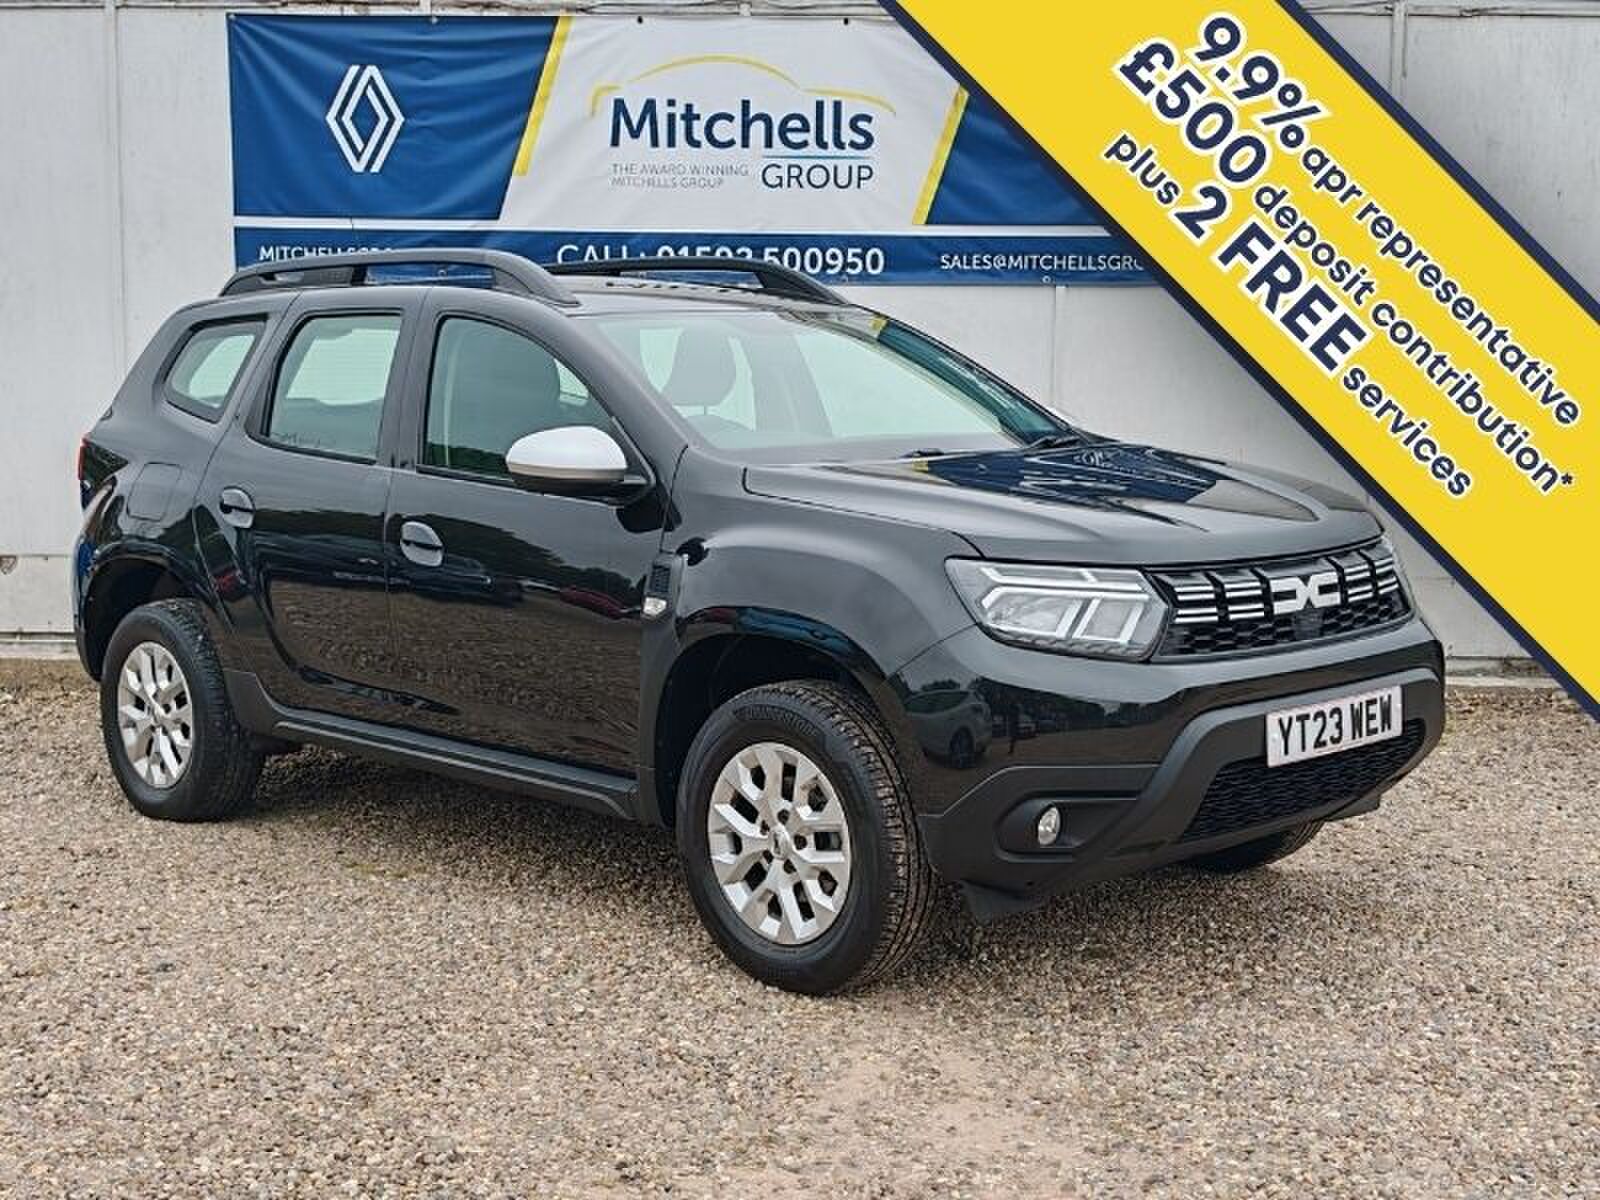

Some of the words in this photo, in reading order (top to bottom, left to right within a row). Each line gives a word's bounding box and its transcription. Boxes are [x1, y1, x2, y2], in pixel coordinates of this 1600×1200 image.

[610, 98, 875, 150] Mitchells
[610, 176, 677, 188] MITCHELLS
[679, 176, 724, 188] GROUP
[612, 163, 638, 175] THE
[640, 163, 687, 175] AWARD
[689, 163, 749, 176] WINNING
[761, 164, 873, 189] GROUP
[763, 247, 885, 275] 500950
[1278, 707, 1343, 756] YT23
[1350, 694, 1392, 740] WEW
